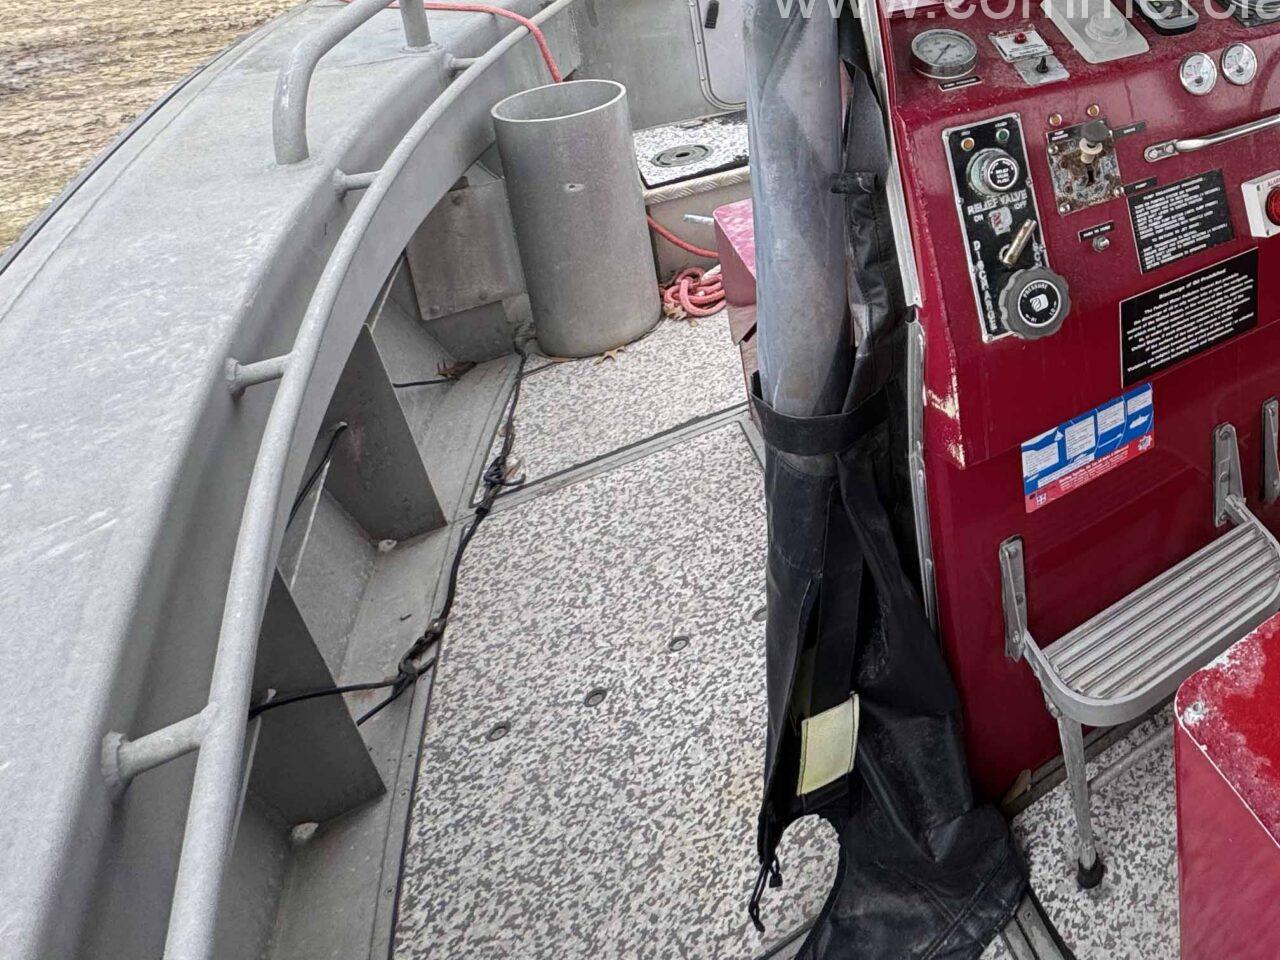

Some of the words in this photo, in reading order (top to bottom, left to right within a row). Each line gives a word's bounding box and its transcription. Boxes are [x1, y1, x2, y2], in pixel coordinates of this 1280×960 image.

[967, 199, 998, 215] RELIEF
[1000, 189, 1028, 205] VALVE
[973, 214, 984, 222] ON
[1023, 283, 1048, 298] PRESSURE
